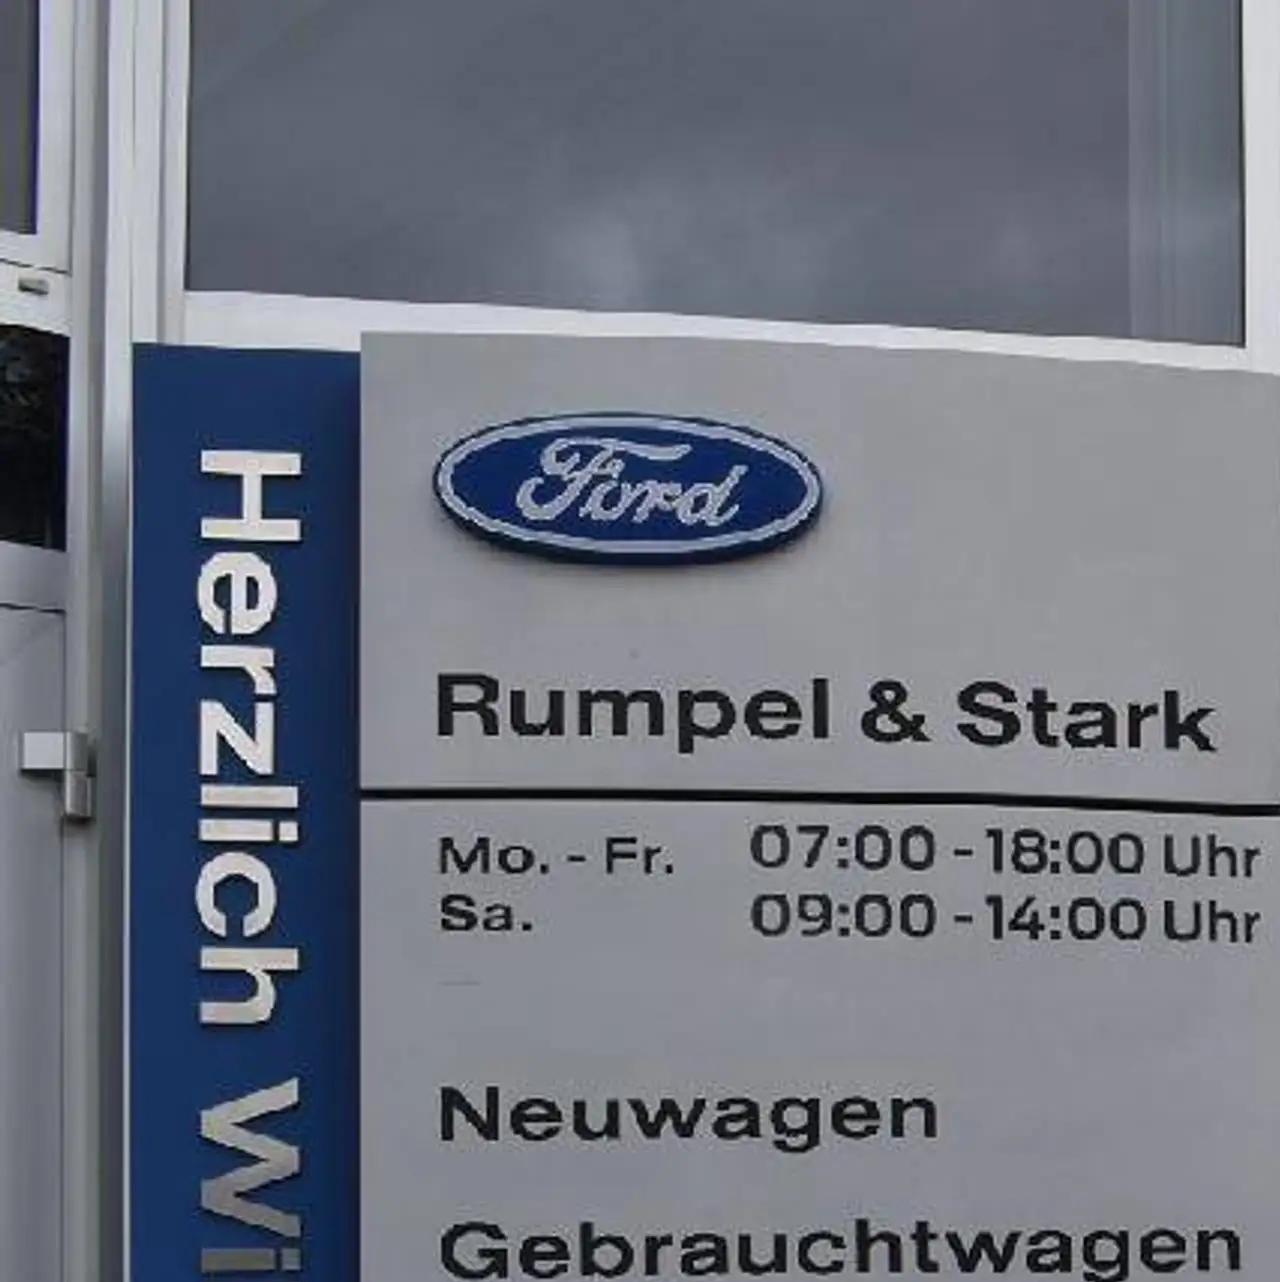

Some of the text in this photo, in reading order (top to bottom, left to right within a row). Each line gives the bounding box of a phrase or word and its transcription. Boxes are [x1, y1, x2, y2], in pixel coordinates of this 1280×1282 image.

[516, 436, 749, 527] Ford
[196, 449, 301, 1025] Herzlich
[437, 673, 1216, 754] Rumpel & Stark
[440, 836, 549, 875] Mo.
[606, 836, 674, 875] Fr.
[1164, 834, 1260, 878] Uhr
[440, 894, 533, 933] Sa.
[1163, 899, 1261, 943] Uhr
[440, 1086, 937, 1154] Neuwagen
